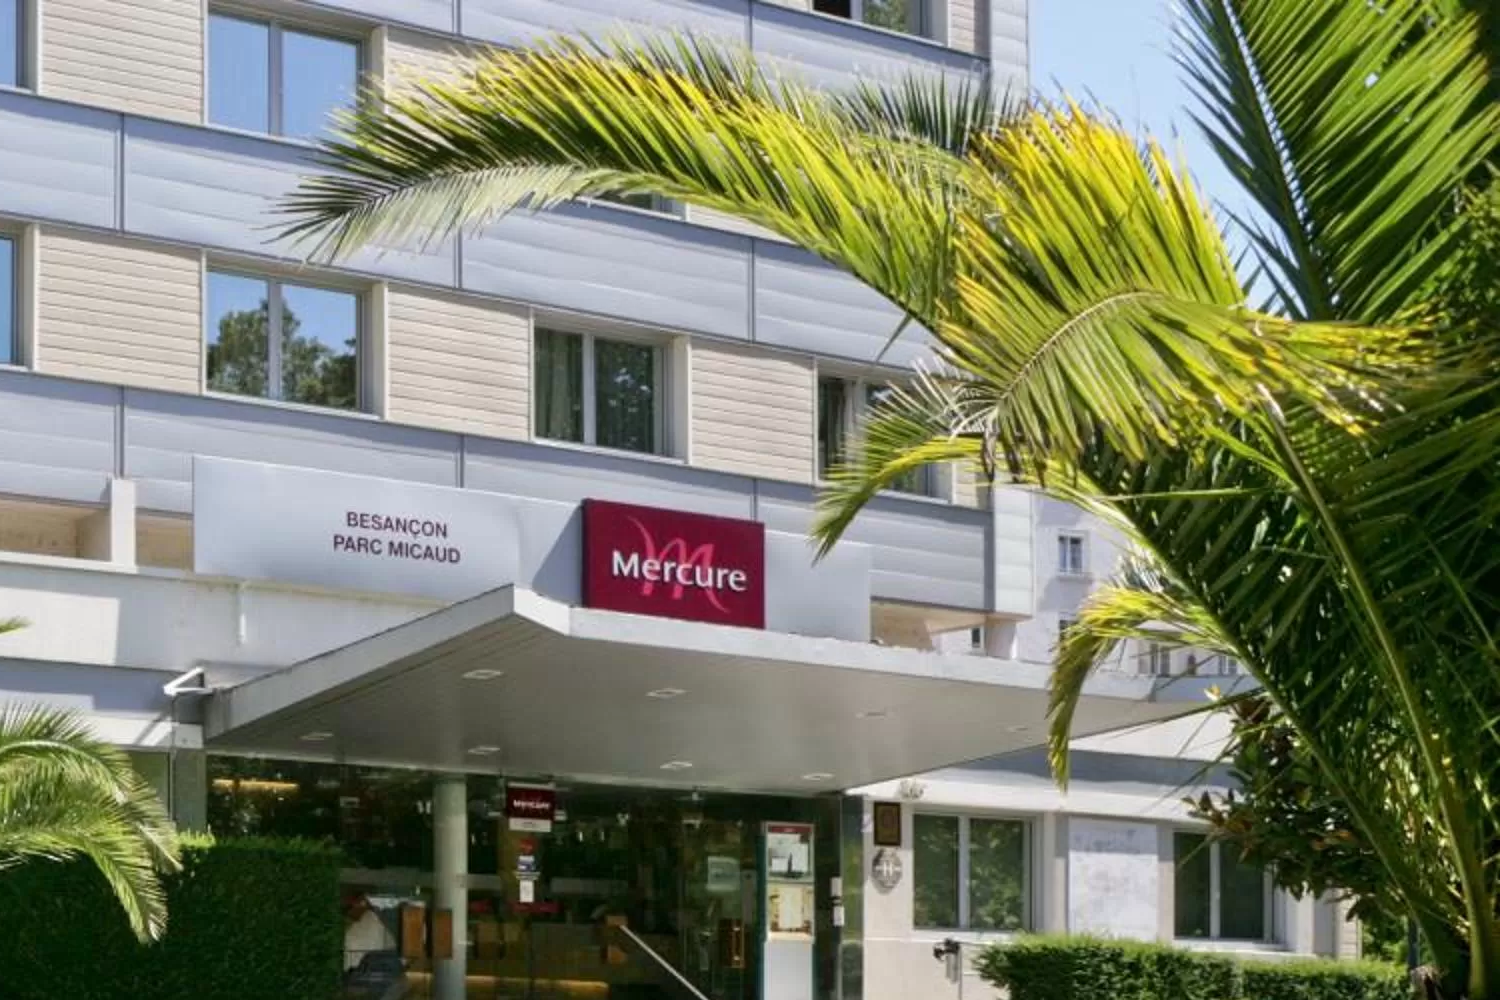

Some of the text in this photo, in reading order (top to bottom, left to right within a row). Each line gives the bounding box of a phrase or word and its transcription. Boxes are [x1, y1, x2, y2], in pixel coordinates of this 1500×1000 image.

[346, 511, 448, 539] BESANÇON
[333, 533, 461, 563] PARC MICAUD
[611, 549, 748, 592] Mercure
